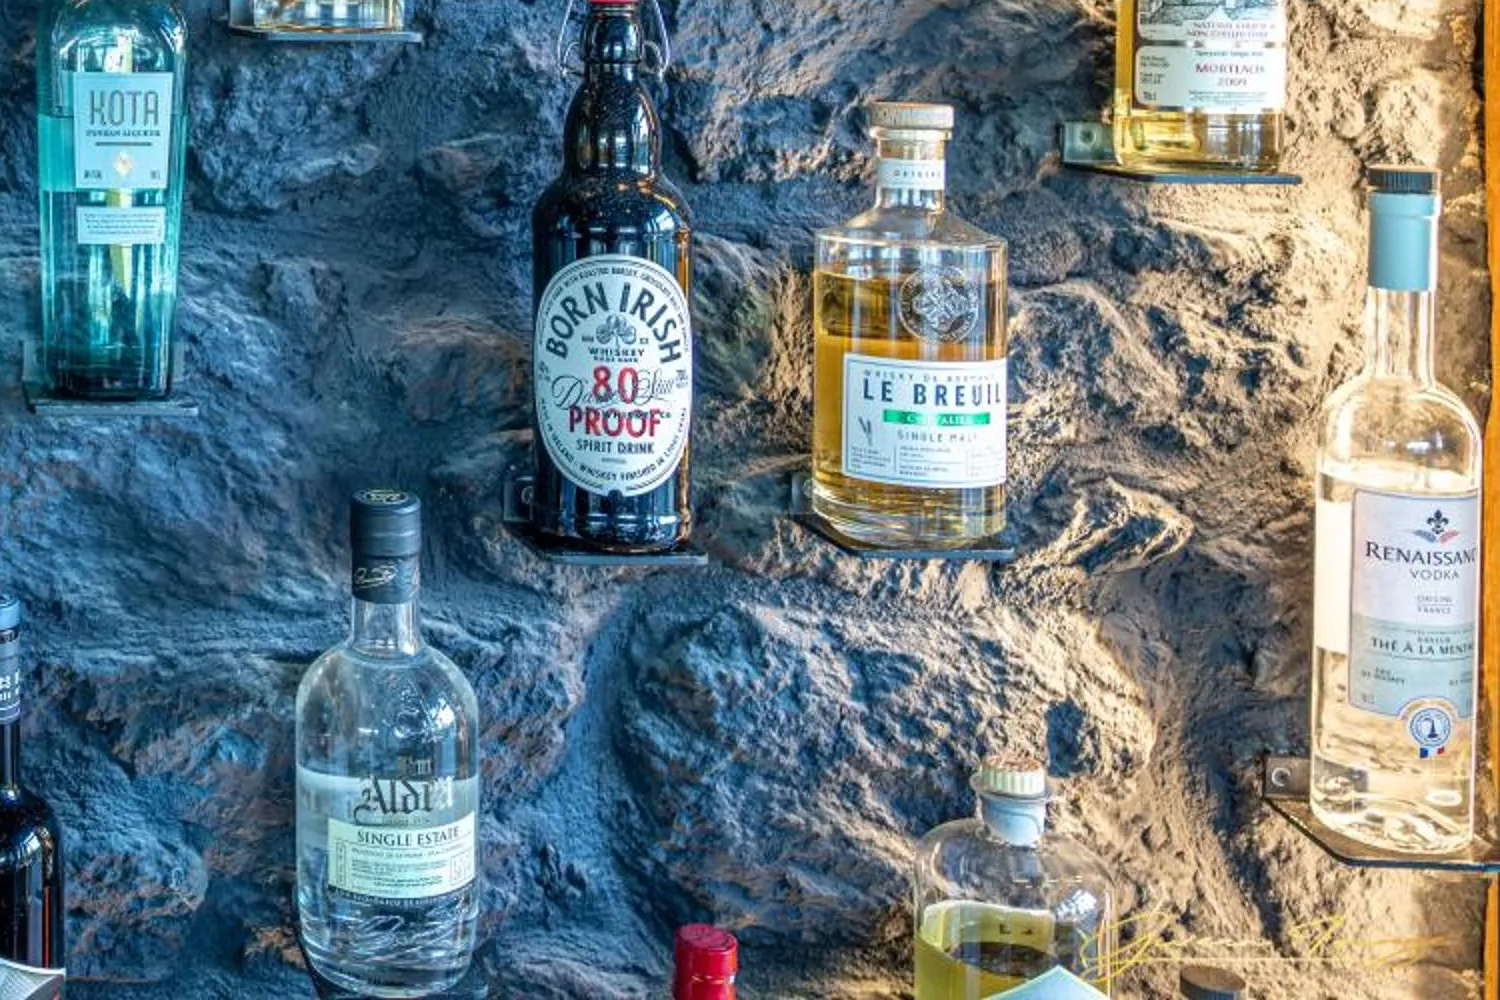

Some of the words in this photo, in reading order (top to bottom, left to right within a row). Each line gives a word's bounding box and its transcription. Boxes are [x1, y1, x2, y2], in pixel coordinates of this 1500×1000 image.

[1194, 63, 1266, 74] MORTLACH
[88, 89, 161, 127] KOTA
[545, 281, 611, 361] BORN
[618, 281, 682, 365] IRISH
[586, 347, 645, 357] WHISKEY
[592, 365, 639, 406] 80
[862, 378, 894, 403] LE
[912, 382, 1003, 408] BREUIL
[567, 404, 663, 440] PROOF
[897, 430, 943, 444] SINGLE
[576, 438, 612, 455] SPIRIT
[616, 439, 656, 456] DRINK
[579, 463, 618, 482] WHISKEY
[1409, 568, 1461, 581] VODKA
[1418, 641, 1435, 656] LA
[357, 830, 413, 847] SINGLE
[416, 825, 460, 847] ESTATE
